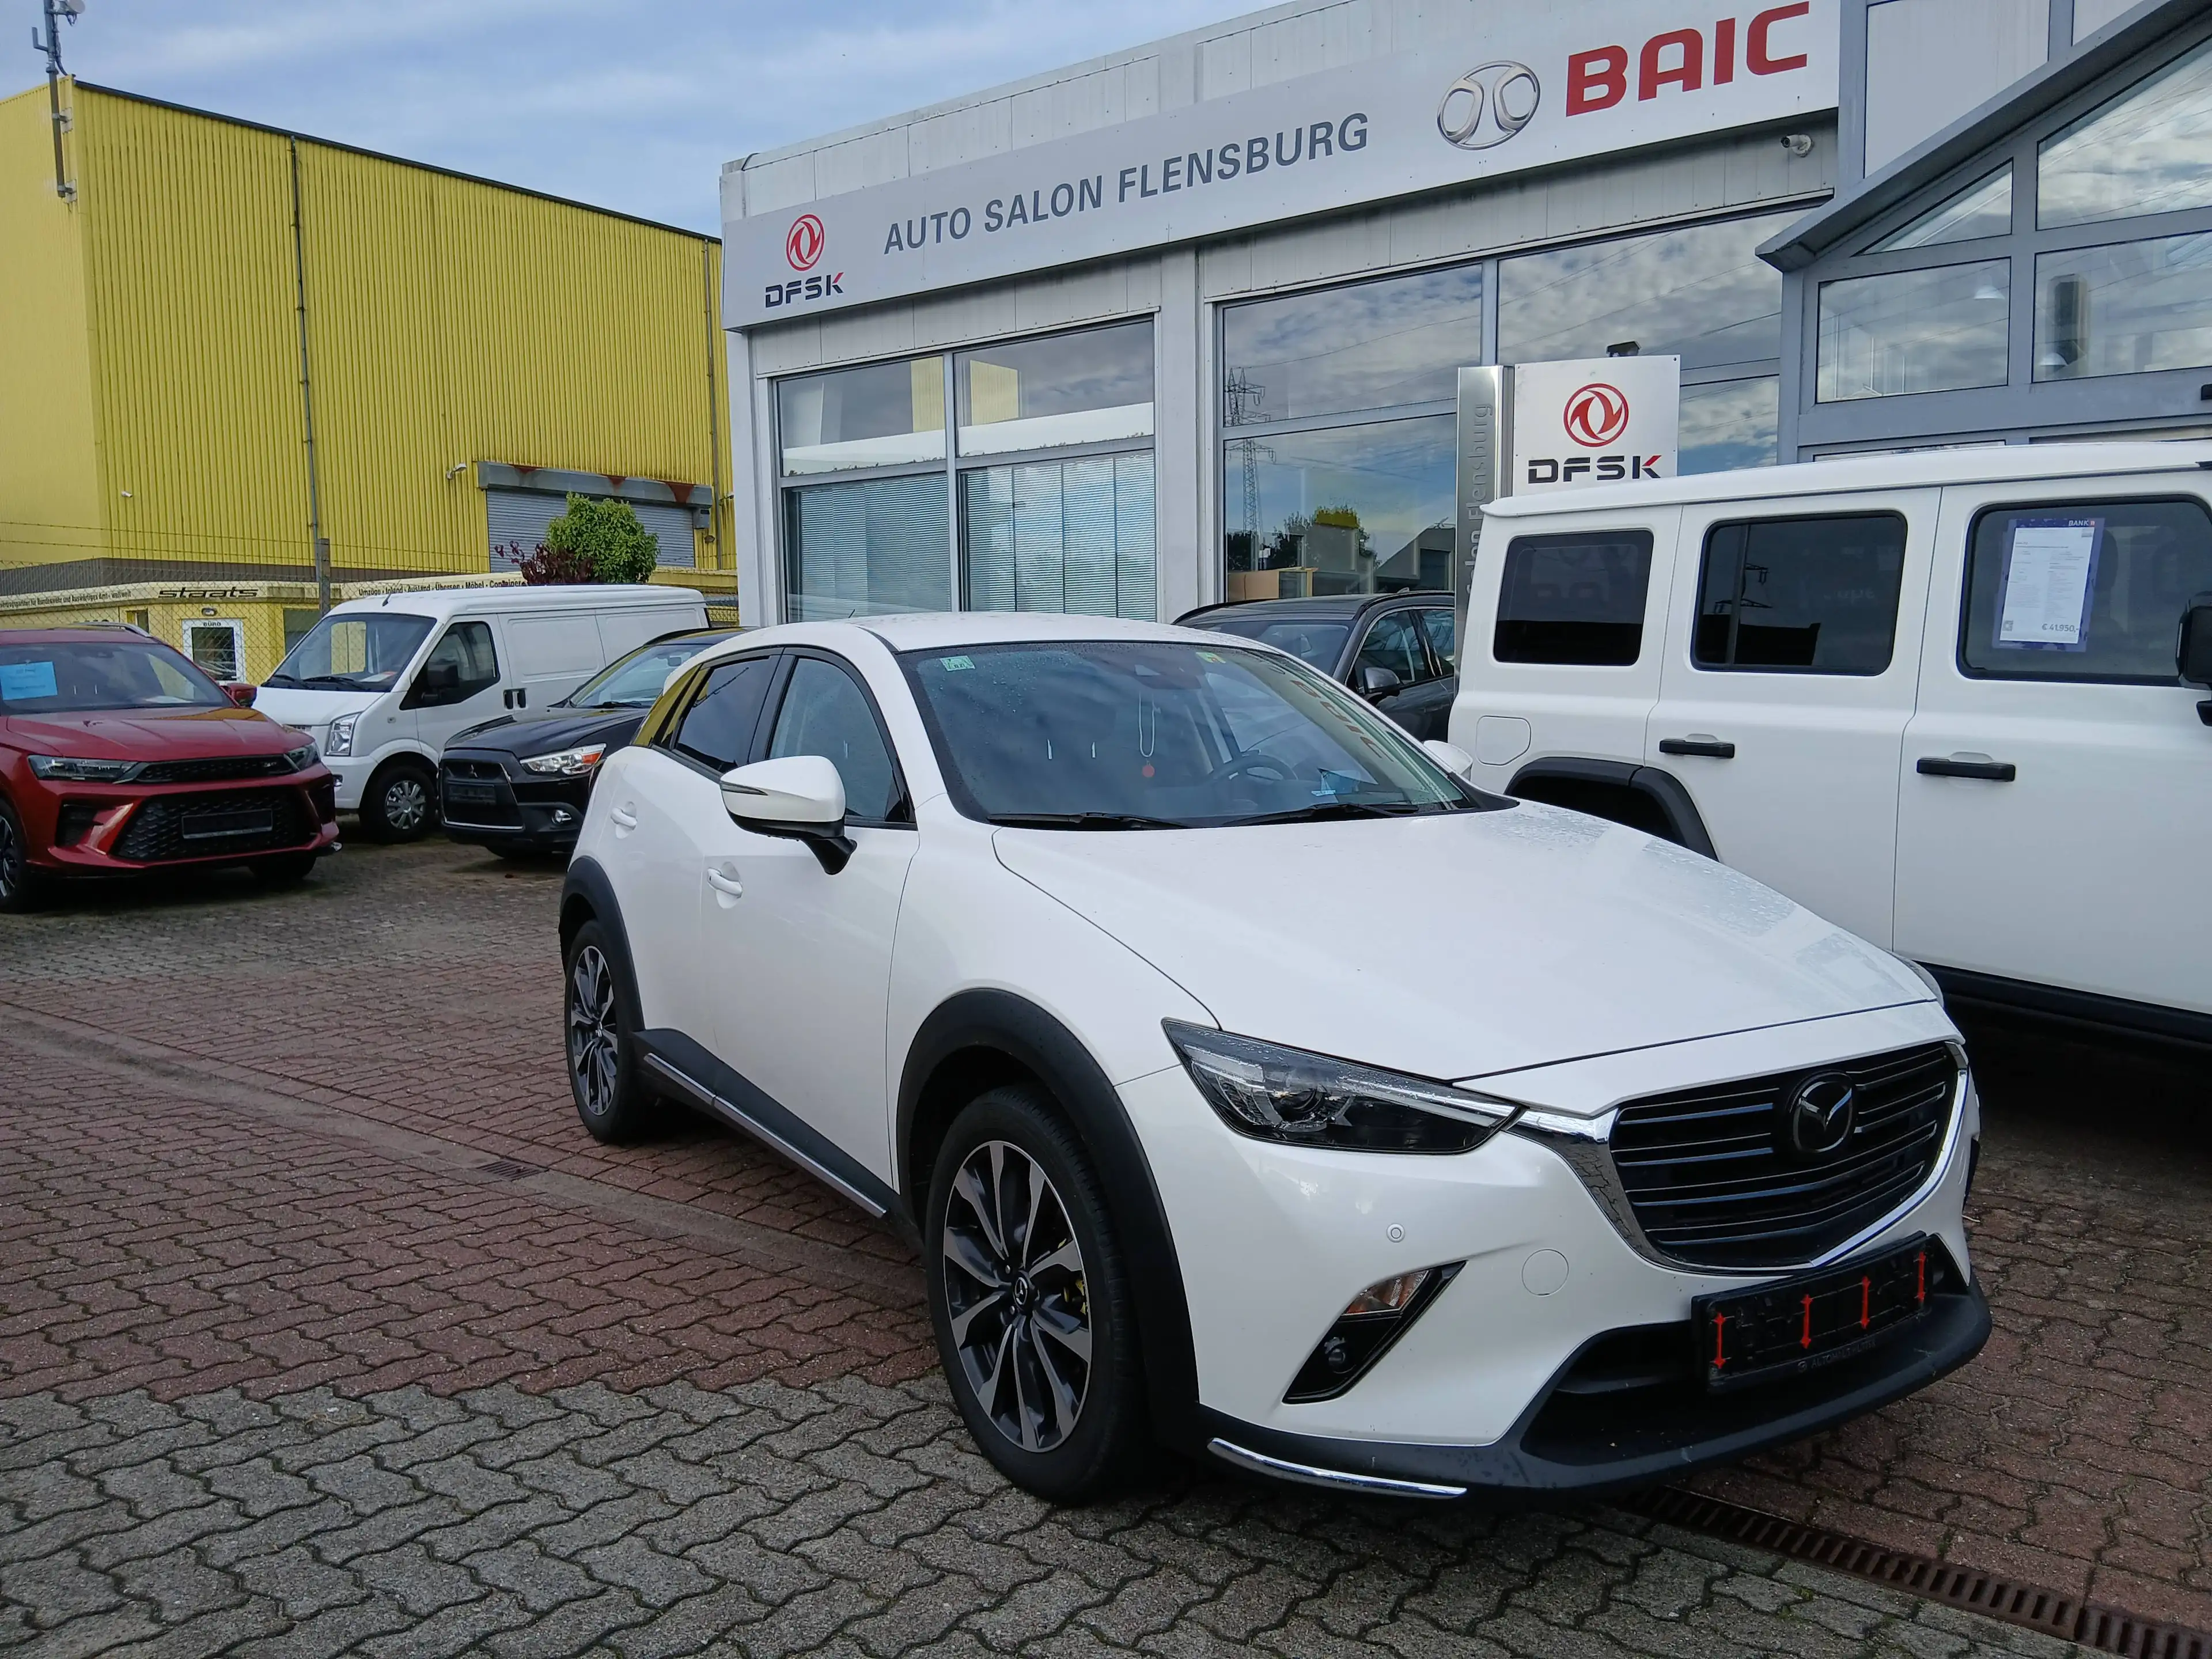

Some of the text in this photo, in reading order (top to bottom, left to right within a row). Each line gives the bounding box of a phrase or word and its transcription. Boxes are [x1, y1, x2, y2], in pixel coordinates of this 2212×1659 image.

[1566, 1, 1810, 118] BAIC
[884, 112, 1368, 256] AUTO SALON FLENSBURG
[764, 271, 844, 308] DFSK
[1466, 404, 1493, 521] Flensburg
[1528, 454, 1662, 484] DFSK
[158, 586, 259, 598] staats
[465, 581, 484, 589] Möbel
